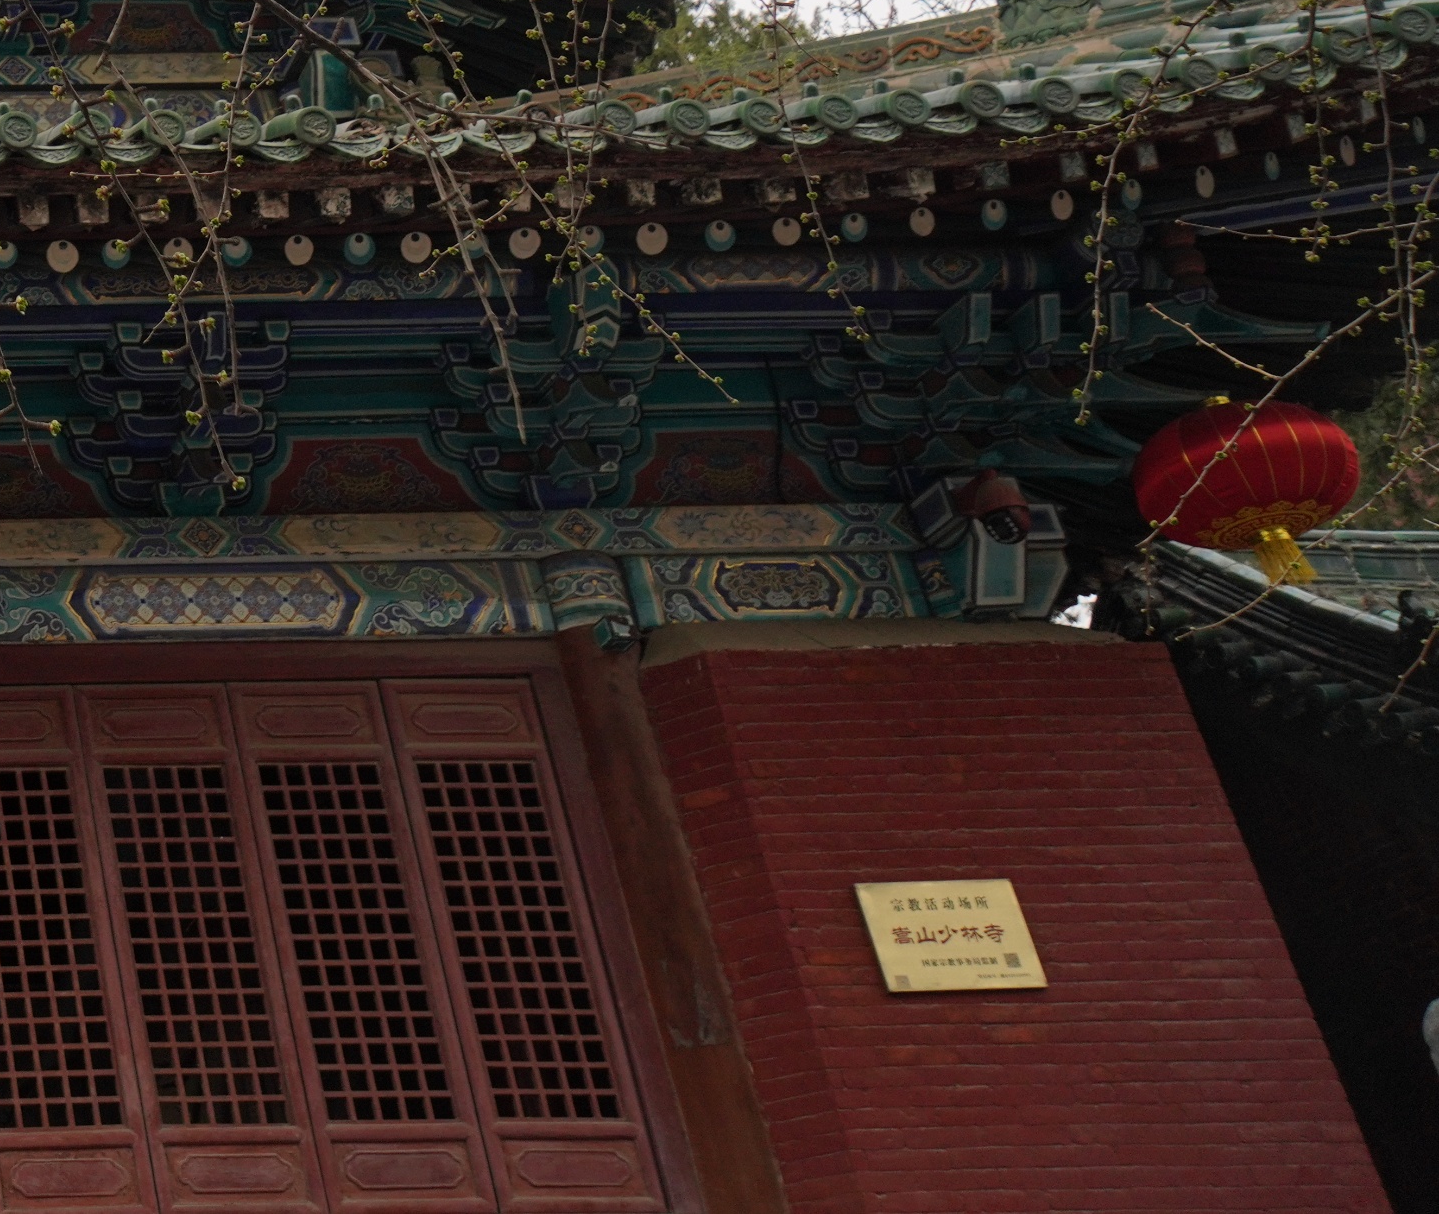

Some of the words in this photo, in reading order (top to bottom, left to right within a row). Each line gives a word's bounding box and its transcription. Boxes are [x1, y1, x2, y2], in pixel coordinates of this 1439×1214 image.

[890, 896, 989, 912] 宗教活动场所
[892, 924, 1004, 944] 嵩山少林寺
